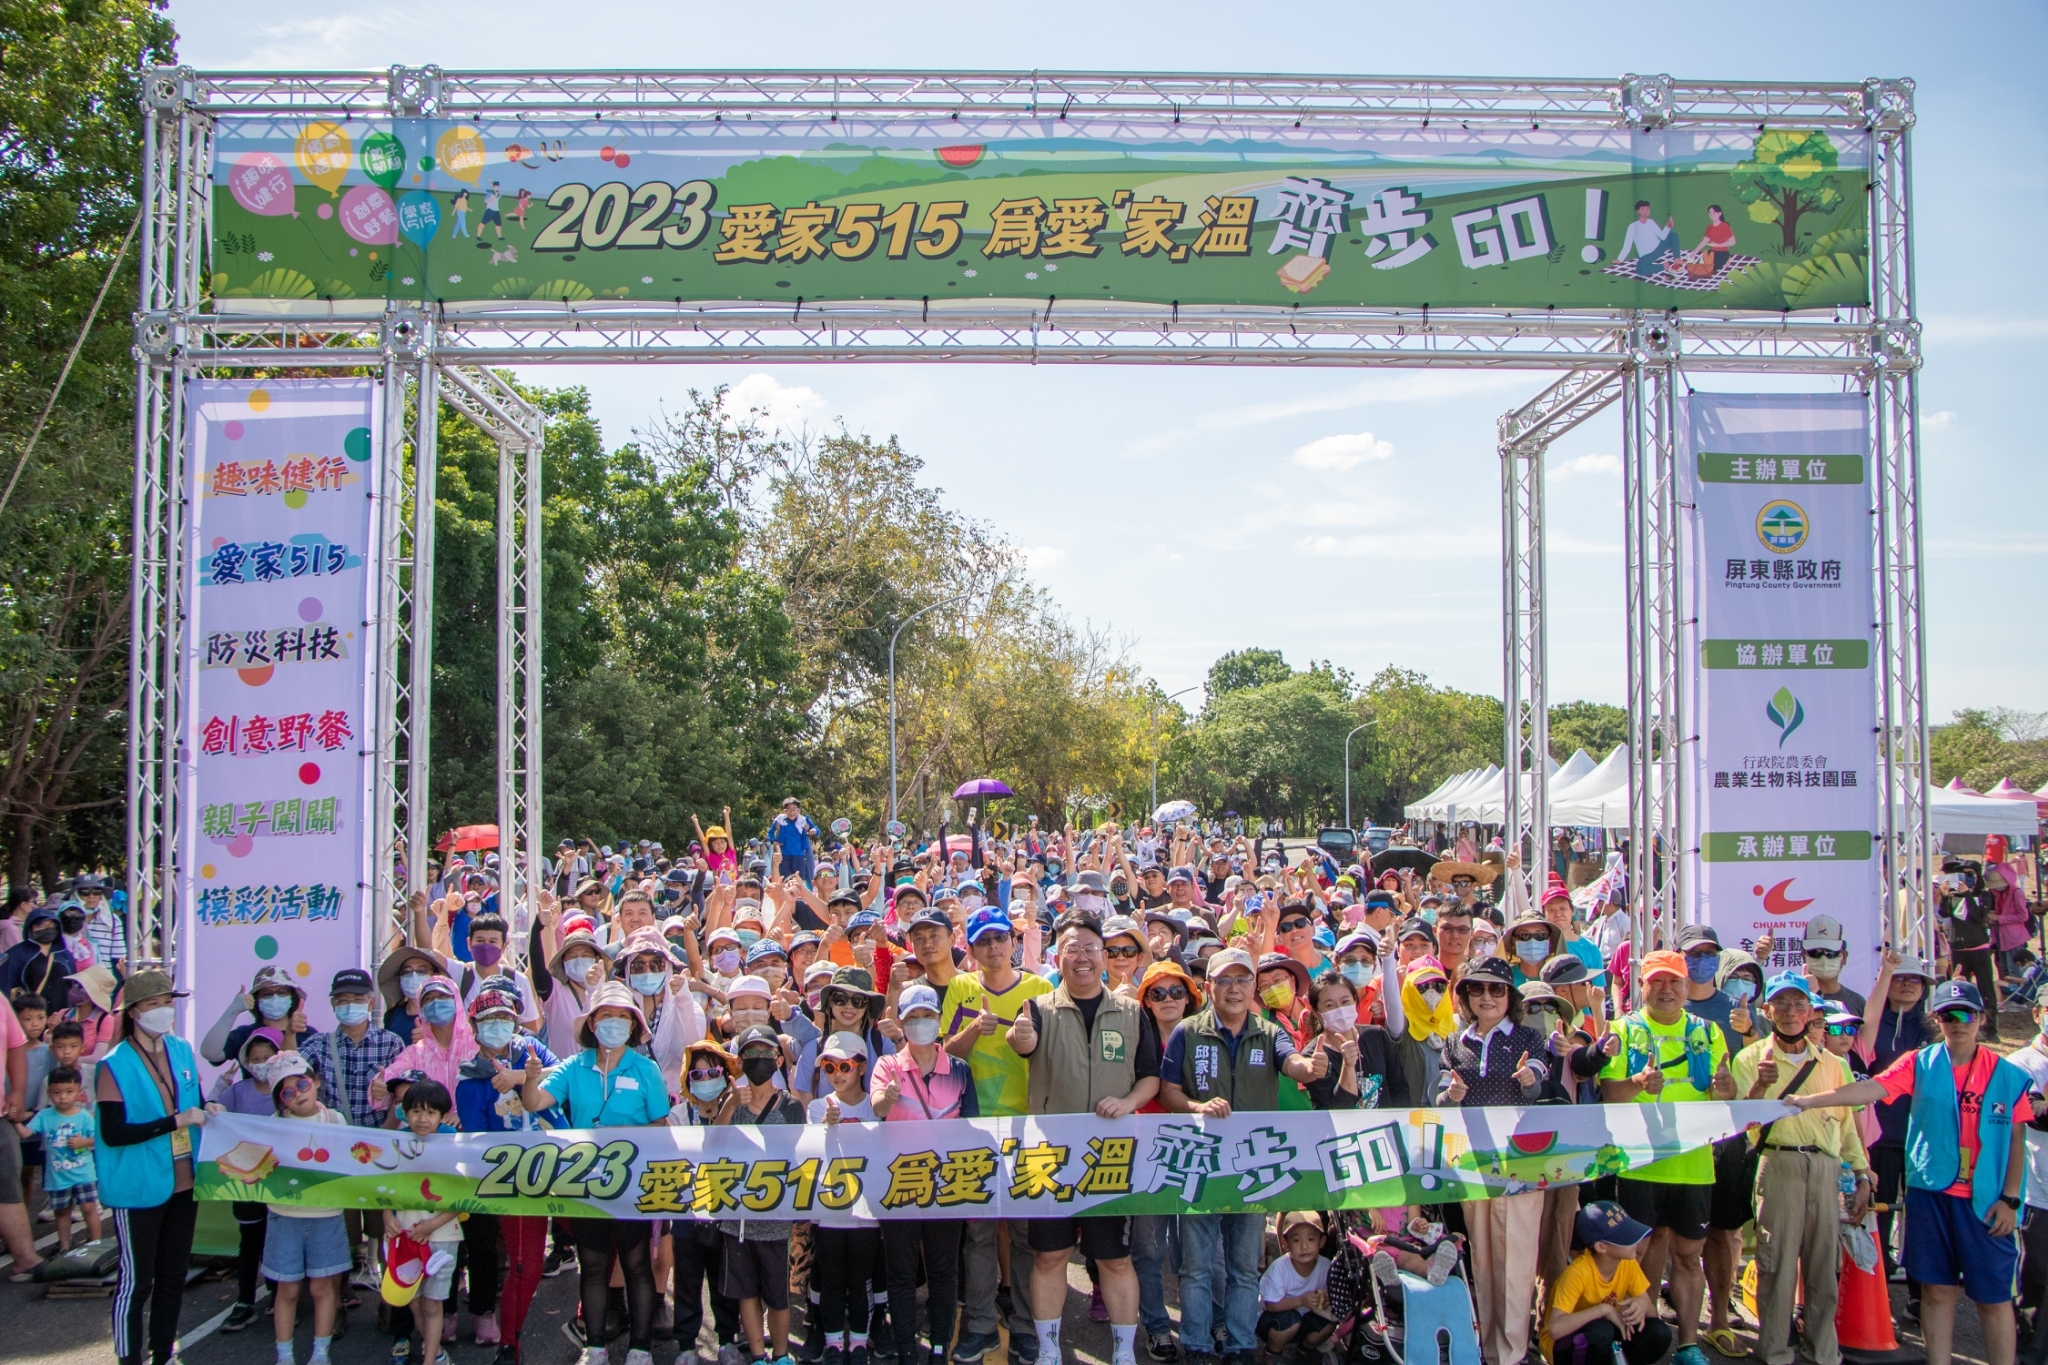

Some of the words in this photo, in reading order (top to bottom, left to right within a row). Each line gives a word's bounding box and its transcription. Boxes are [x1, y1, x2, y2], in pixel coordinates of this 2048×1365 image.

[533, 180, 718, 253] 2023
[212, 455, 349, 497] 趣味健行
[1730, 457, 1828, 482] 主辦單位
[210, 541, 347, 585] 愛家515
[1725, 559, 1842, 580] 屏東縣政府
[1725, 581, 1760, 589] Pingtung
[1762, 581, 1791, 590] County
[1793, 581, 1842, 589] Government
[206, 625, 342, 666] 防災科技
[1736, 643, 1834, 667] 協辦單位
[200, 709, 353, 755] 創意野餐
[1742, 755, 1828, 770] 行政院農委會
[1714, 770, 1858, 789] 農業生物科技園區
[201, 795, 338, 838] 親子闖關
[1736, 834, 1837, 859] 承辦單位
[196, 883, 343, 924] 摸彩活動
[1753, 921, 1786, 929] CHUAN
[1789, 921, 1809, 929] TUN
[1951, 985, 1961, 997] B
[1195, 1044, 1210, 1091] 邱家弘
[476, 1139, 638, 1199] 2023
